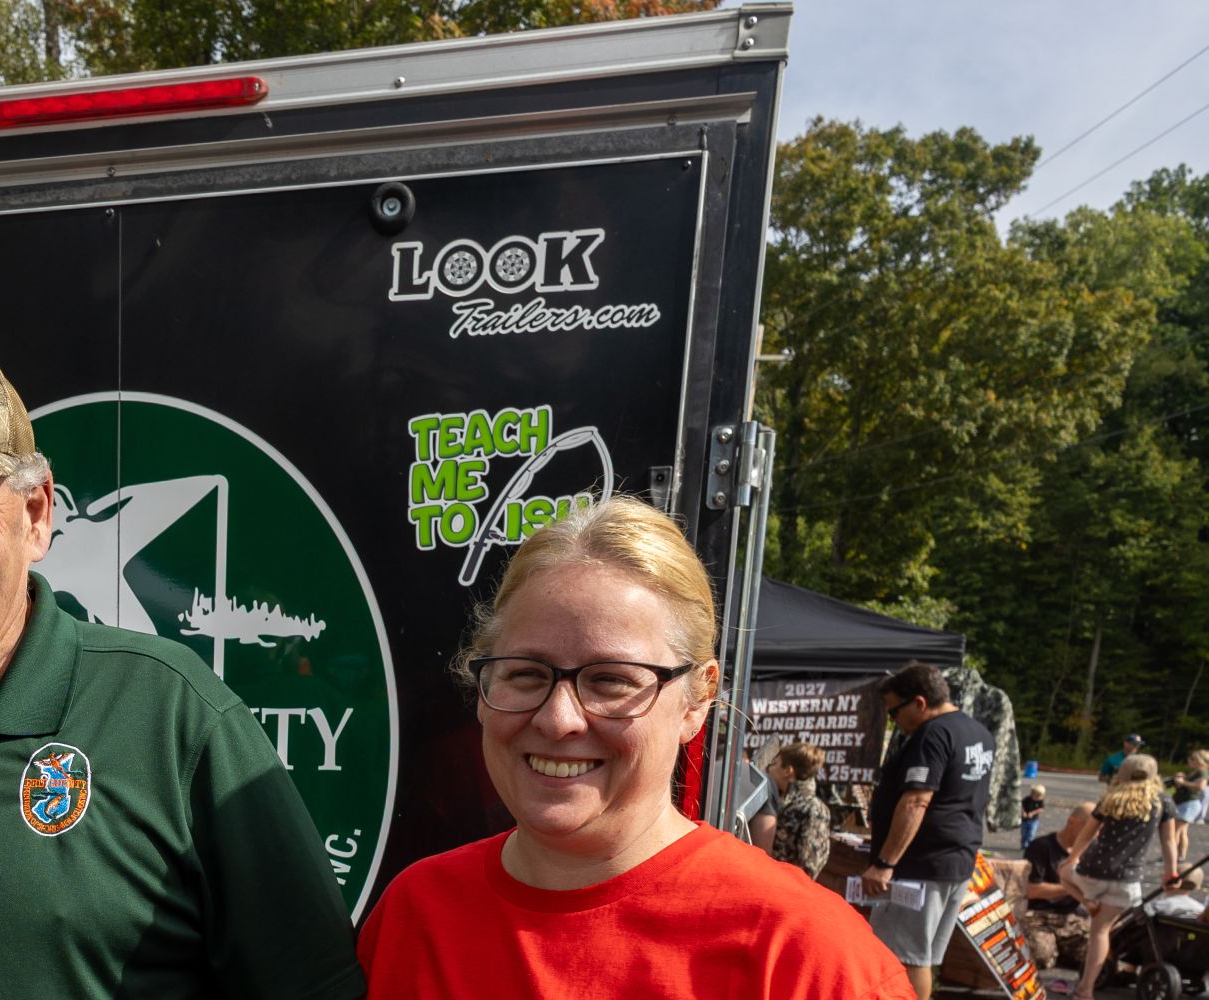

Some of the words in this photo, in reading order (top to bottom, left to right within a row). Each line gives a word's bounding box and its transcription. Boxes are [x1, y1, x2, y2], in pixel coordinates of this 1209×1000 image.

[391, 231, 603, 299] LOOK
[451, 298, 660, 338] Trailers.com
[409, 407, 551, 461] TEACH
[411, 459, 486, 504] ME
[410, 502, 477, 547] TO
[752, 698, 834, 714] WESTERN
[837, 694, 862, 712] NY
[785, 682, 826, 697] 2027
[250, 707, 354, 770] TY
[752, 715, 858, 730] LONGBEARDS
[798, 731, 865, 748] TURKEY
[828, 765, 874, 782] 25TH
[325, 829, 362, 886] NC.
